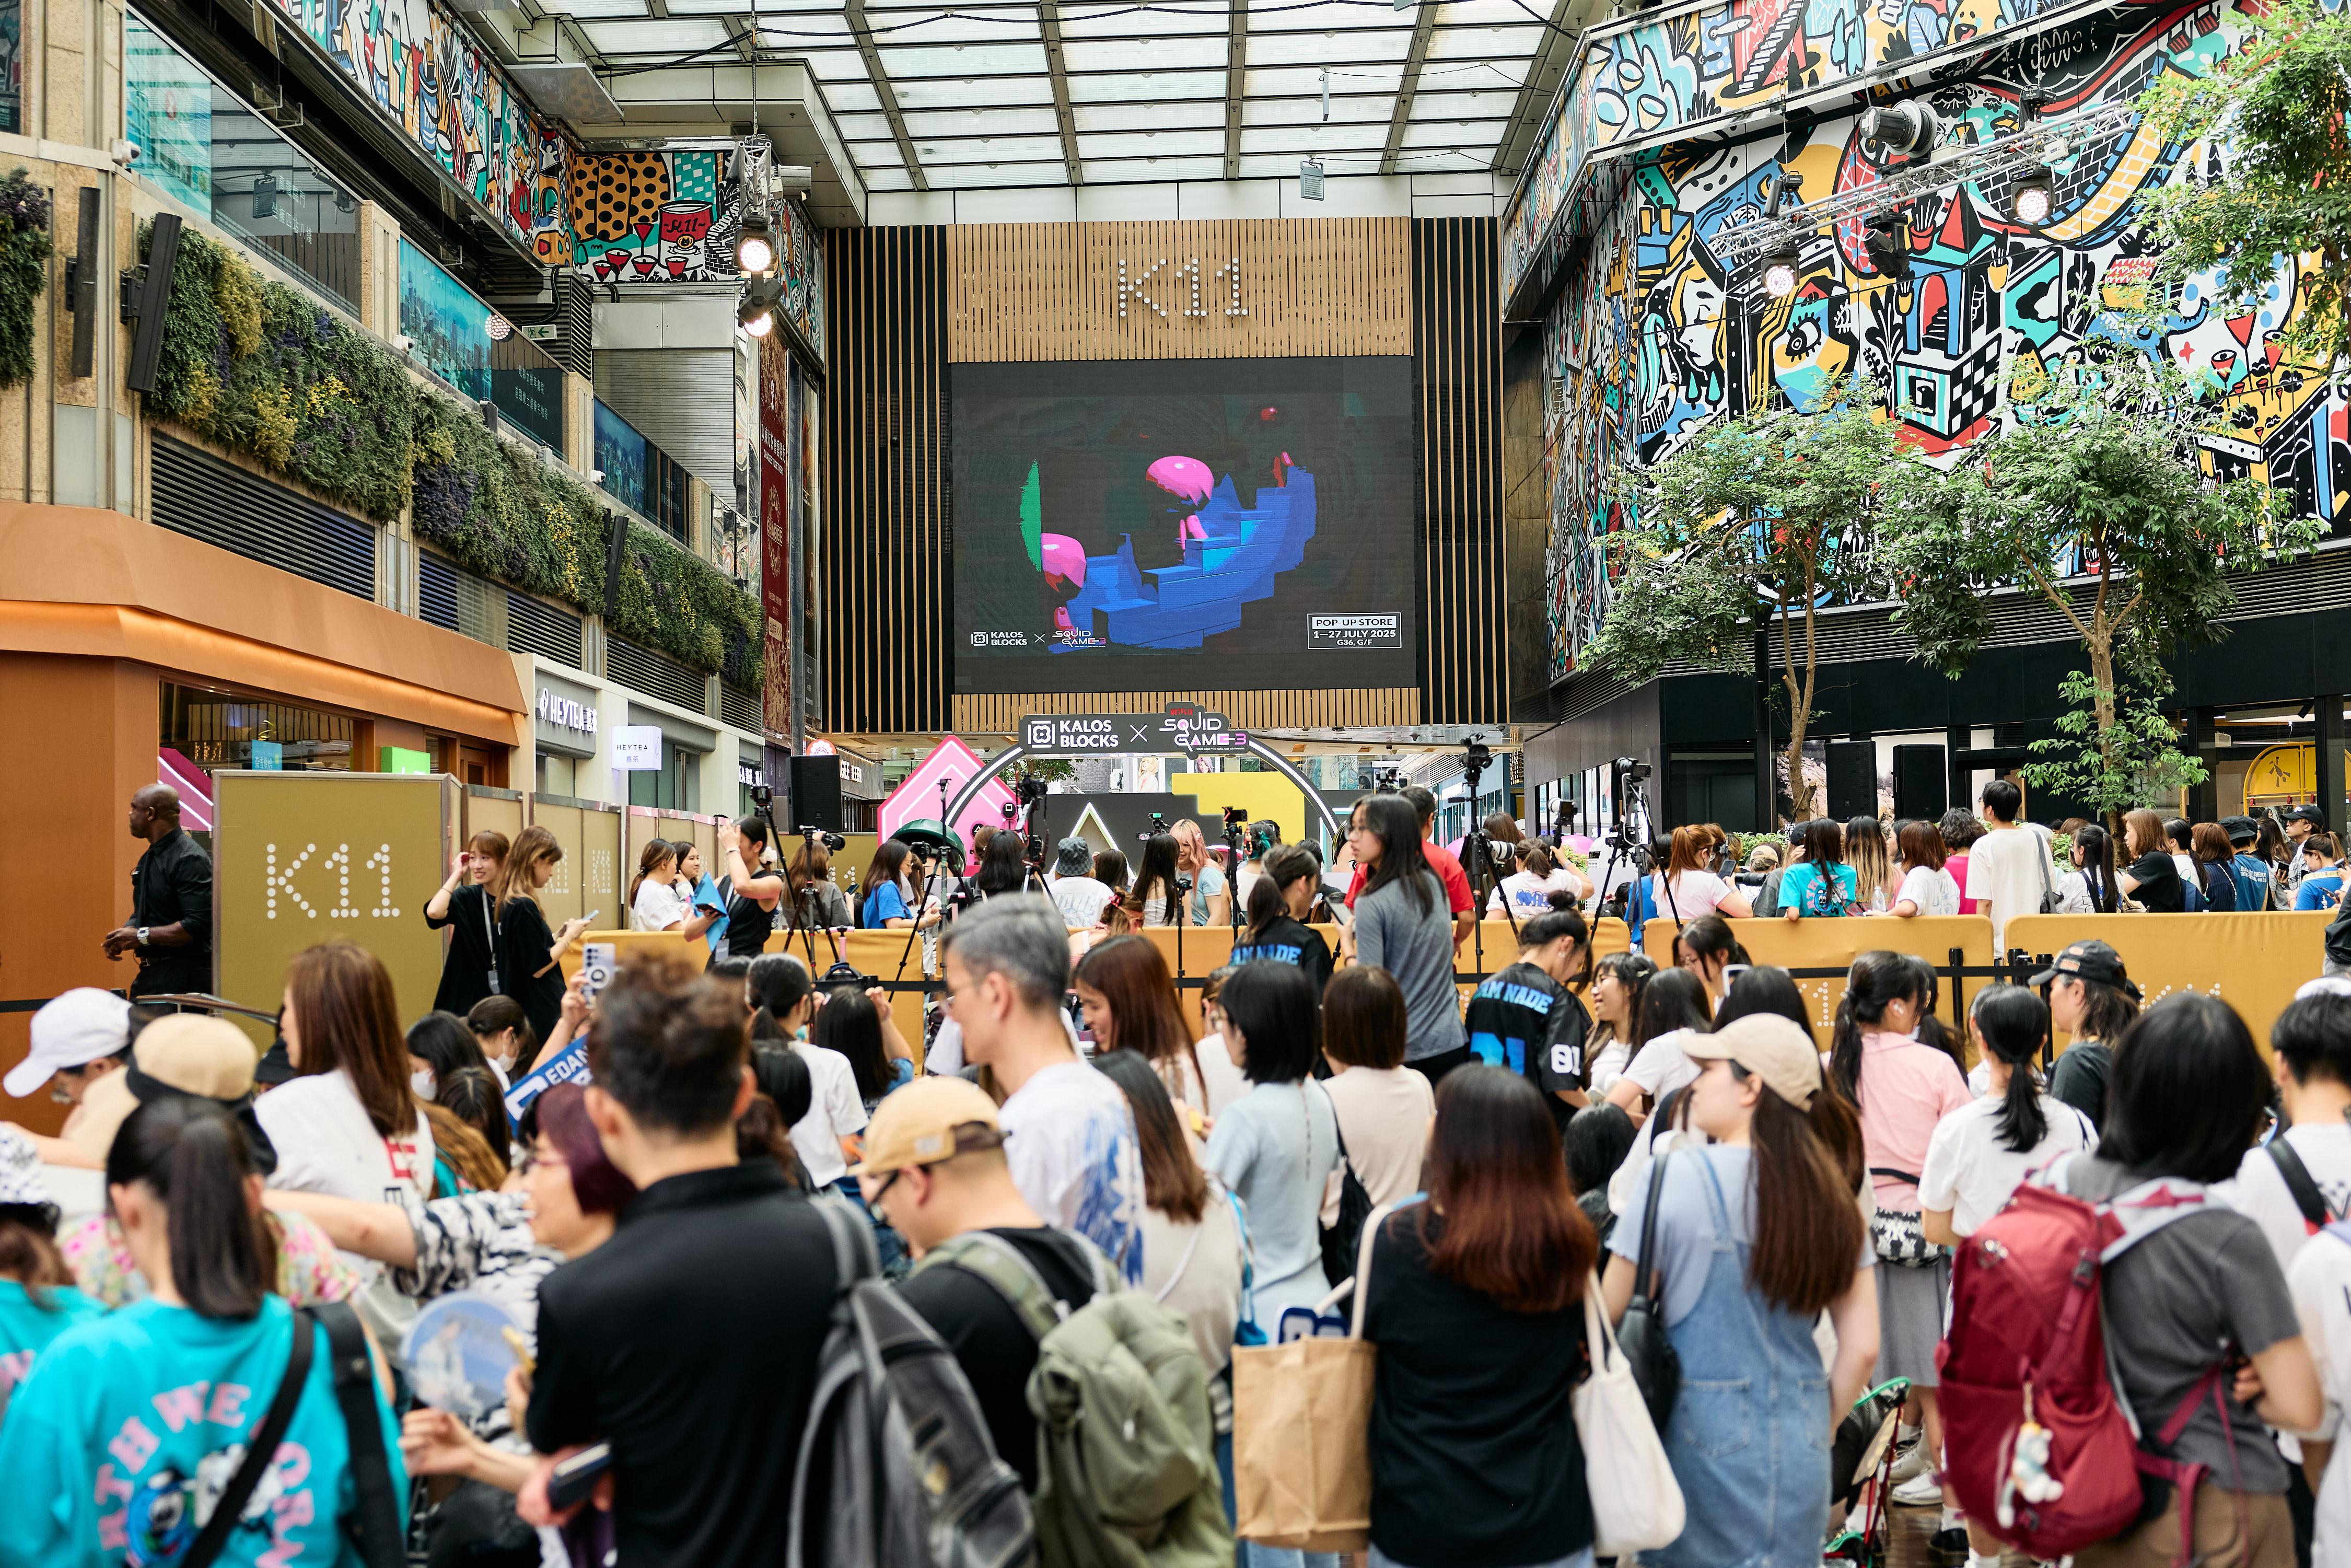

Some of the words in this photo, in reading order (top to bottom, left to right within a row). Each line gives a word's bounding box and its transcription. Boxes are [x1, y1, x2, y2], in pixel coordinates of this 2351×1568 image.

[1119, 258, 1248, 317] K11
[1052, 627, 1091, 638] SQUID
[1343, 630, 1369, 638] JULY
[1370, 629, 1396, 637] 2025
[551, 695, 585, 730] HEYTEA
[586, 706, 598, 734] 喜茶
[1159, 711, 1222, 731] SQUID
[1060, 719, 1112, 733] KALOS
[1060, 734, 1119, 748] BLOCKS
[266, 843, 401, 920] K11
[1503, 983, 1554, 1015] NADE
